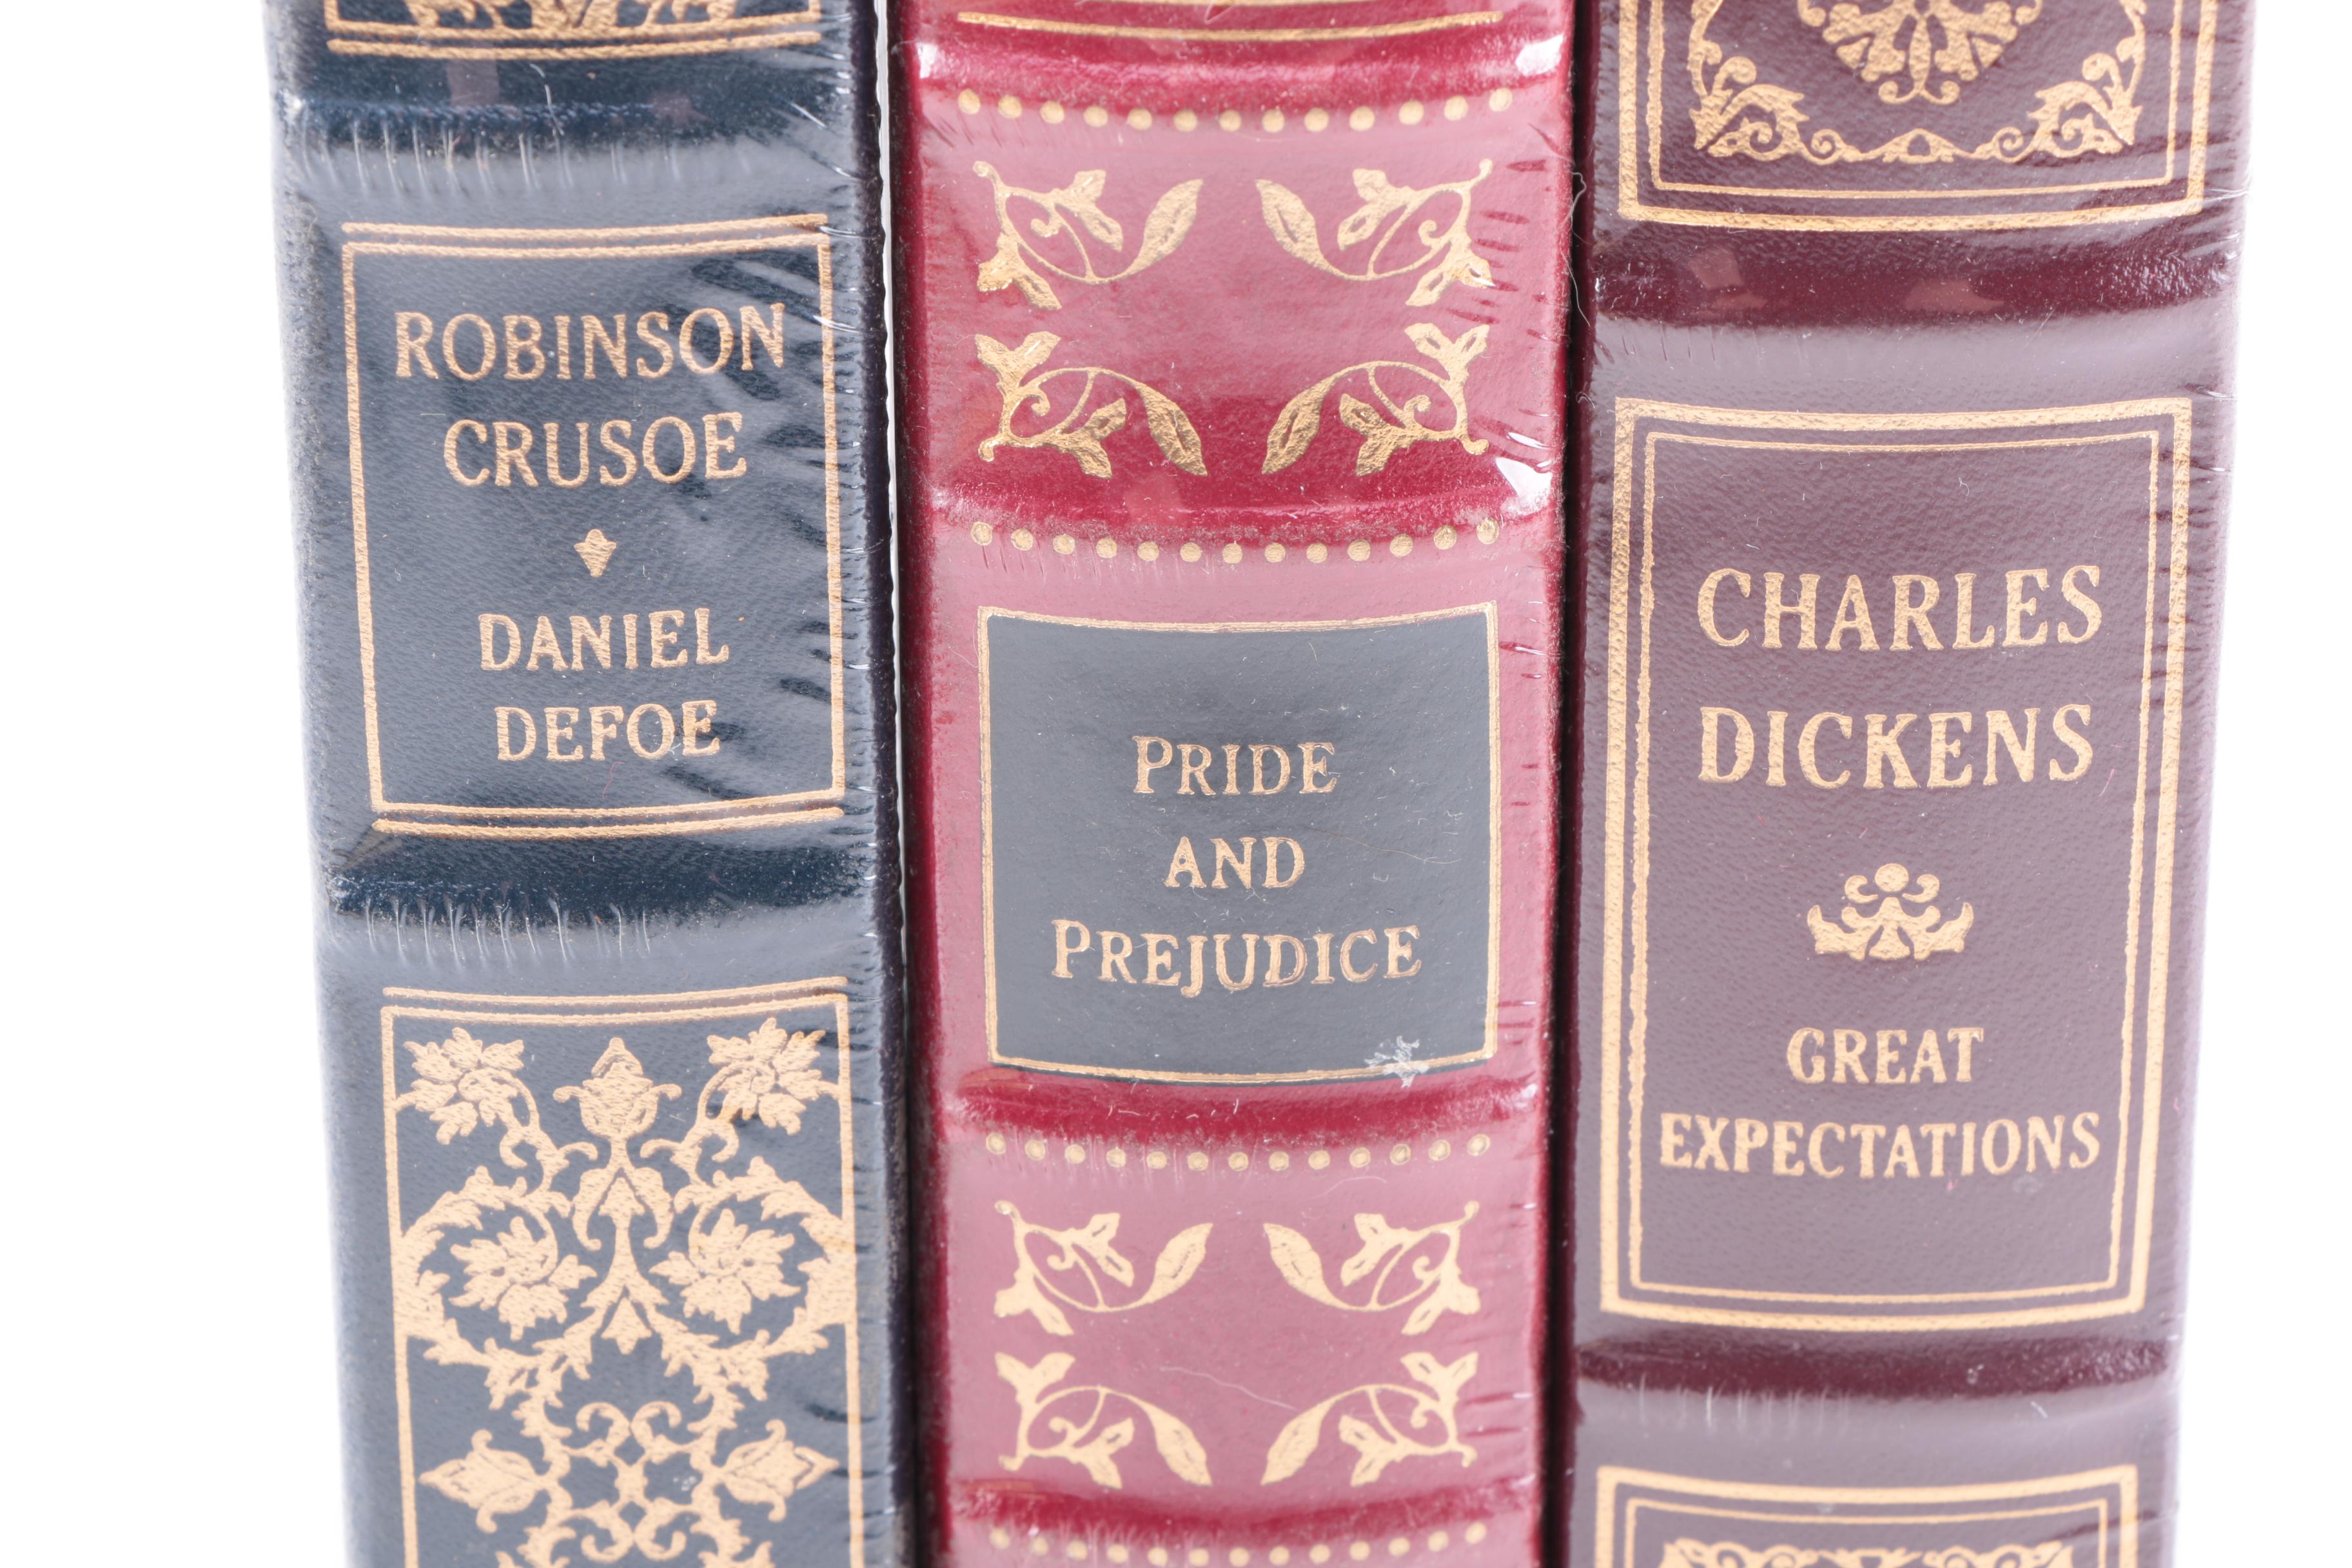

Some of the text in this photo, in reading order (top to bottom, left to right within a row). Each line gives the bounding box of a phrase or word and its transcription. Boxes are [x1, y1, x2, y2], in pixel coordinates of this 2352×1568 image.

[396, 302, 786, 380] ROBINSON
[444, 411, 747, 488] CRUSOE
[478, 607, 730, 671] DANIEL
[1698, 565, 2102, 650] CHARLES
[495, 699, 721, 761] DEFOE
[1699, 704, 2093, 788] DICKENS
[1134, 736, 1337, 795] PRIDE
[1165, 836, 1305, 888] AND
[1053, 919, 1421, 997] PREJUDICE
[1787, 1027, 1984, 1083] GREAT
[1661, 1112, 2101, 1178] EXPECTATIONS
